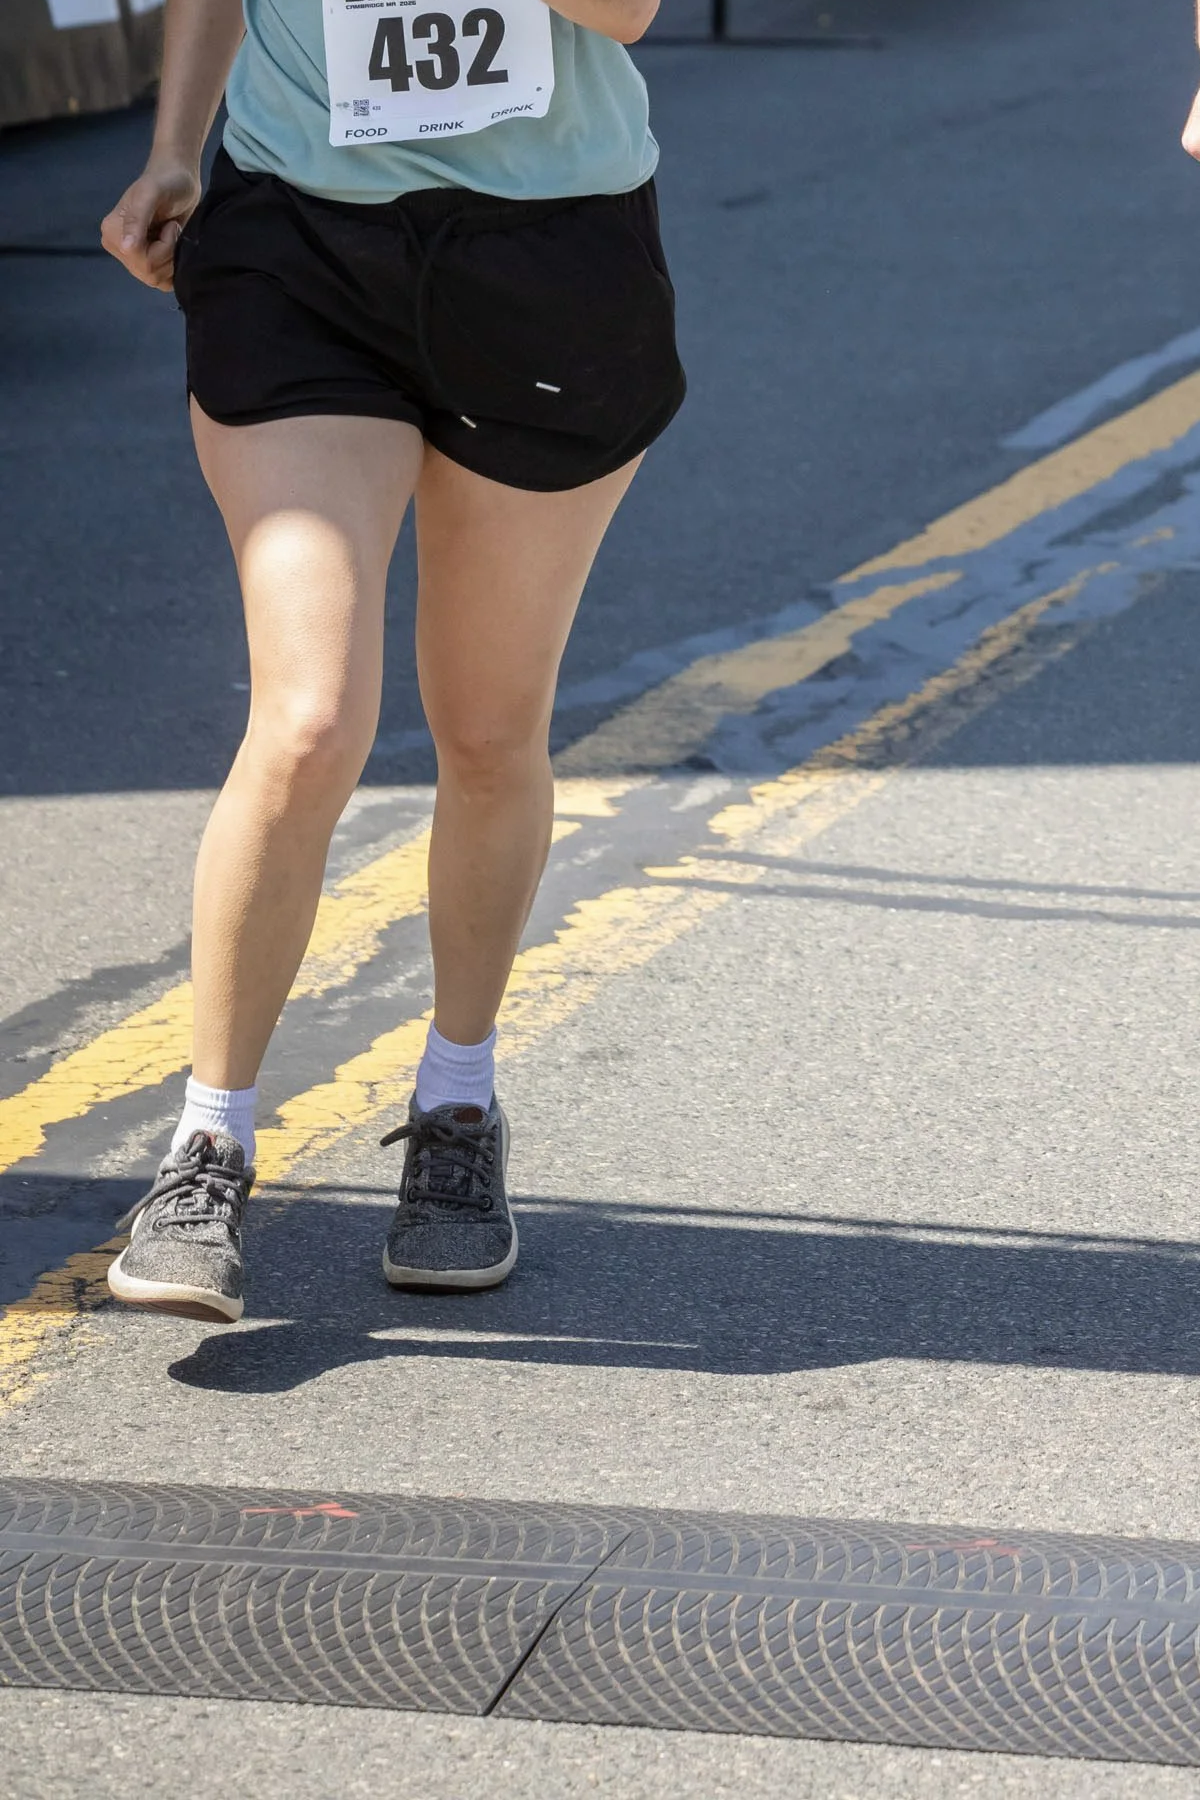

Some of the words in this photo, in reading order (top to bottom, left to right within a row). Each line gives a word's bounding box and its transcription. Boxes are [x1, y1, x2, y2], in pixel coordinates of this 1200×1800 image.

[368, 7, 509, 93] 432
[345, 127, 388, 139] FOOD
[419, 120, 464, 133] DRINK
[490, 103, 535, 119] DRINK
